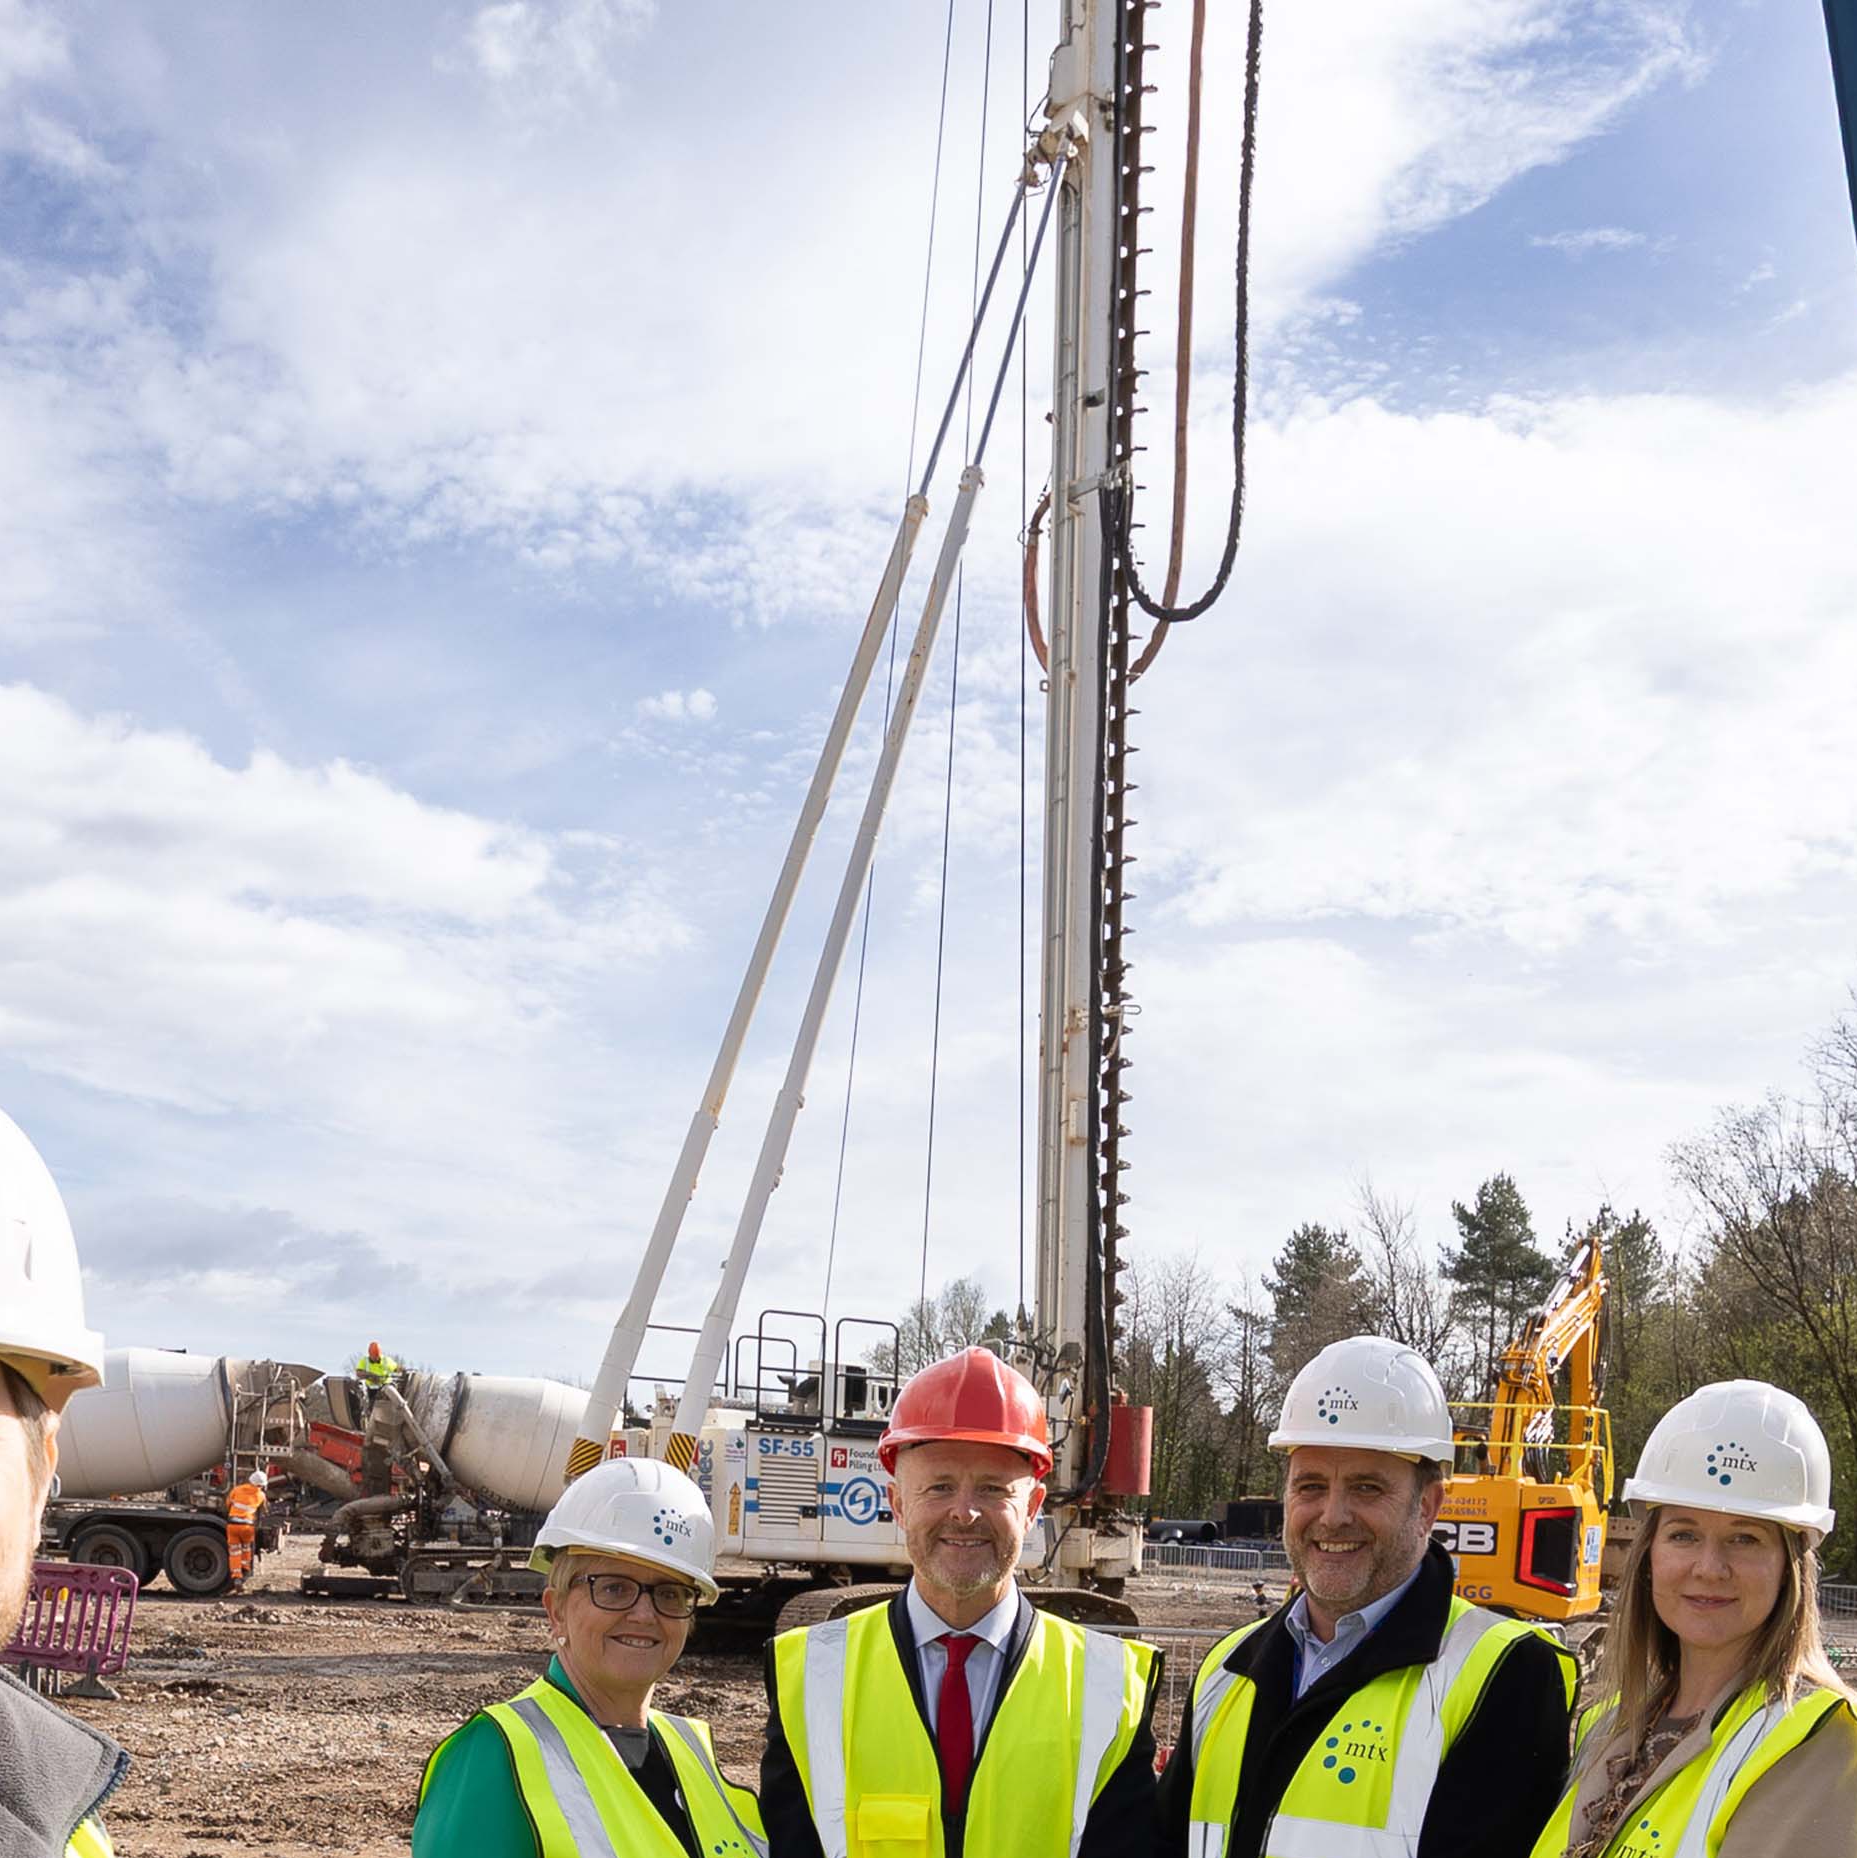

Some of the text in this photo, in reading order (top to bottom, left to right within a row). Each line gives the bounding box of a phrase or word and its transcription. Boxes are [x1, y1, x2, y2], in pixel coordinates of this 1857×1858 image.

[1330, 1399, 1358, 1410] mtx
[758, 1438, 814, 1457] SF-55
[849, 1448, 878, 1459] Found
[1722, 1457, 1758, 1472] mtx
[666, 1520, 692, 1537] mtx
[1431, 1522, 1495, 1553] CB
[1456, 1584, 1492, 1600] IGG
[1345, 1742, 1388, 1761] mtx
